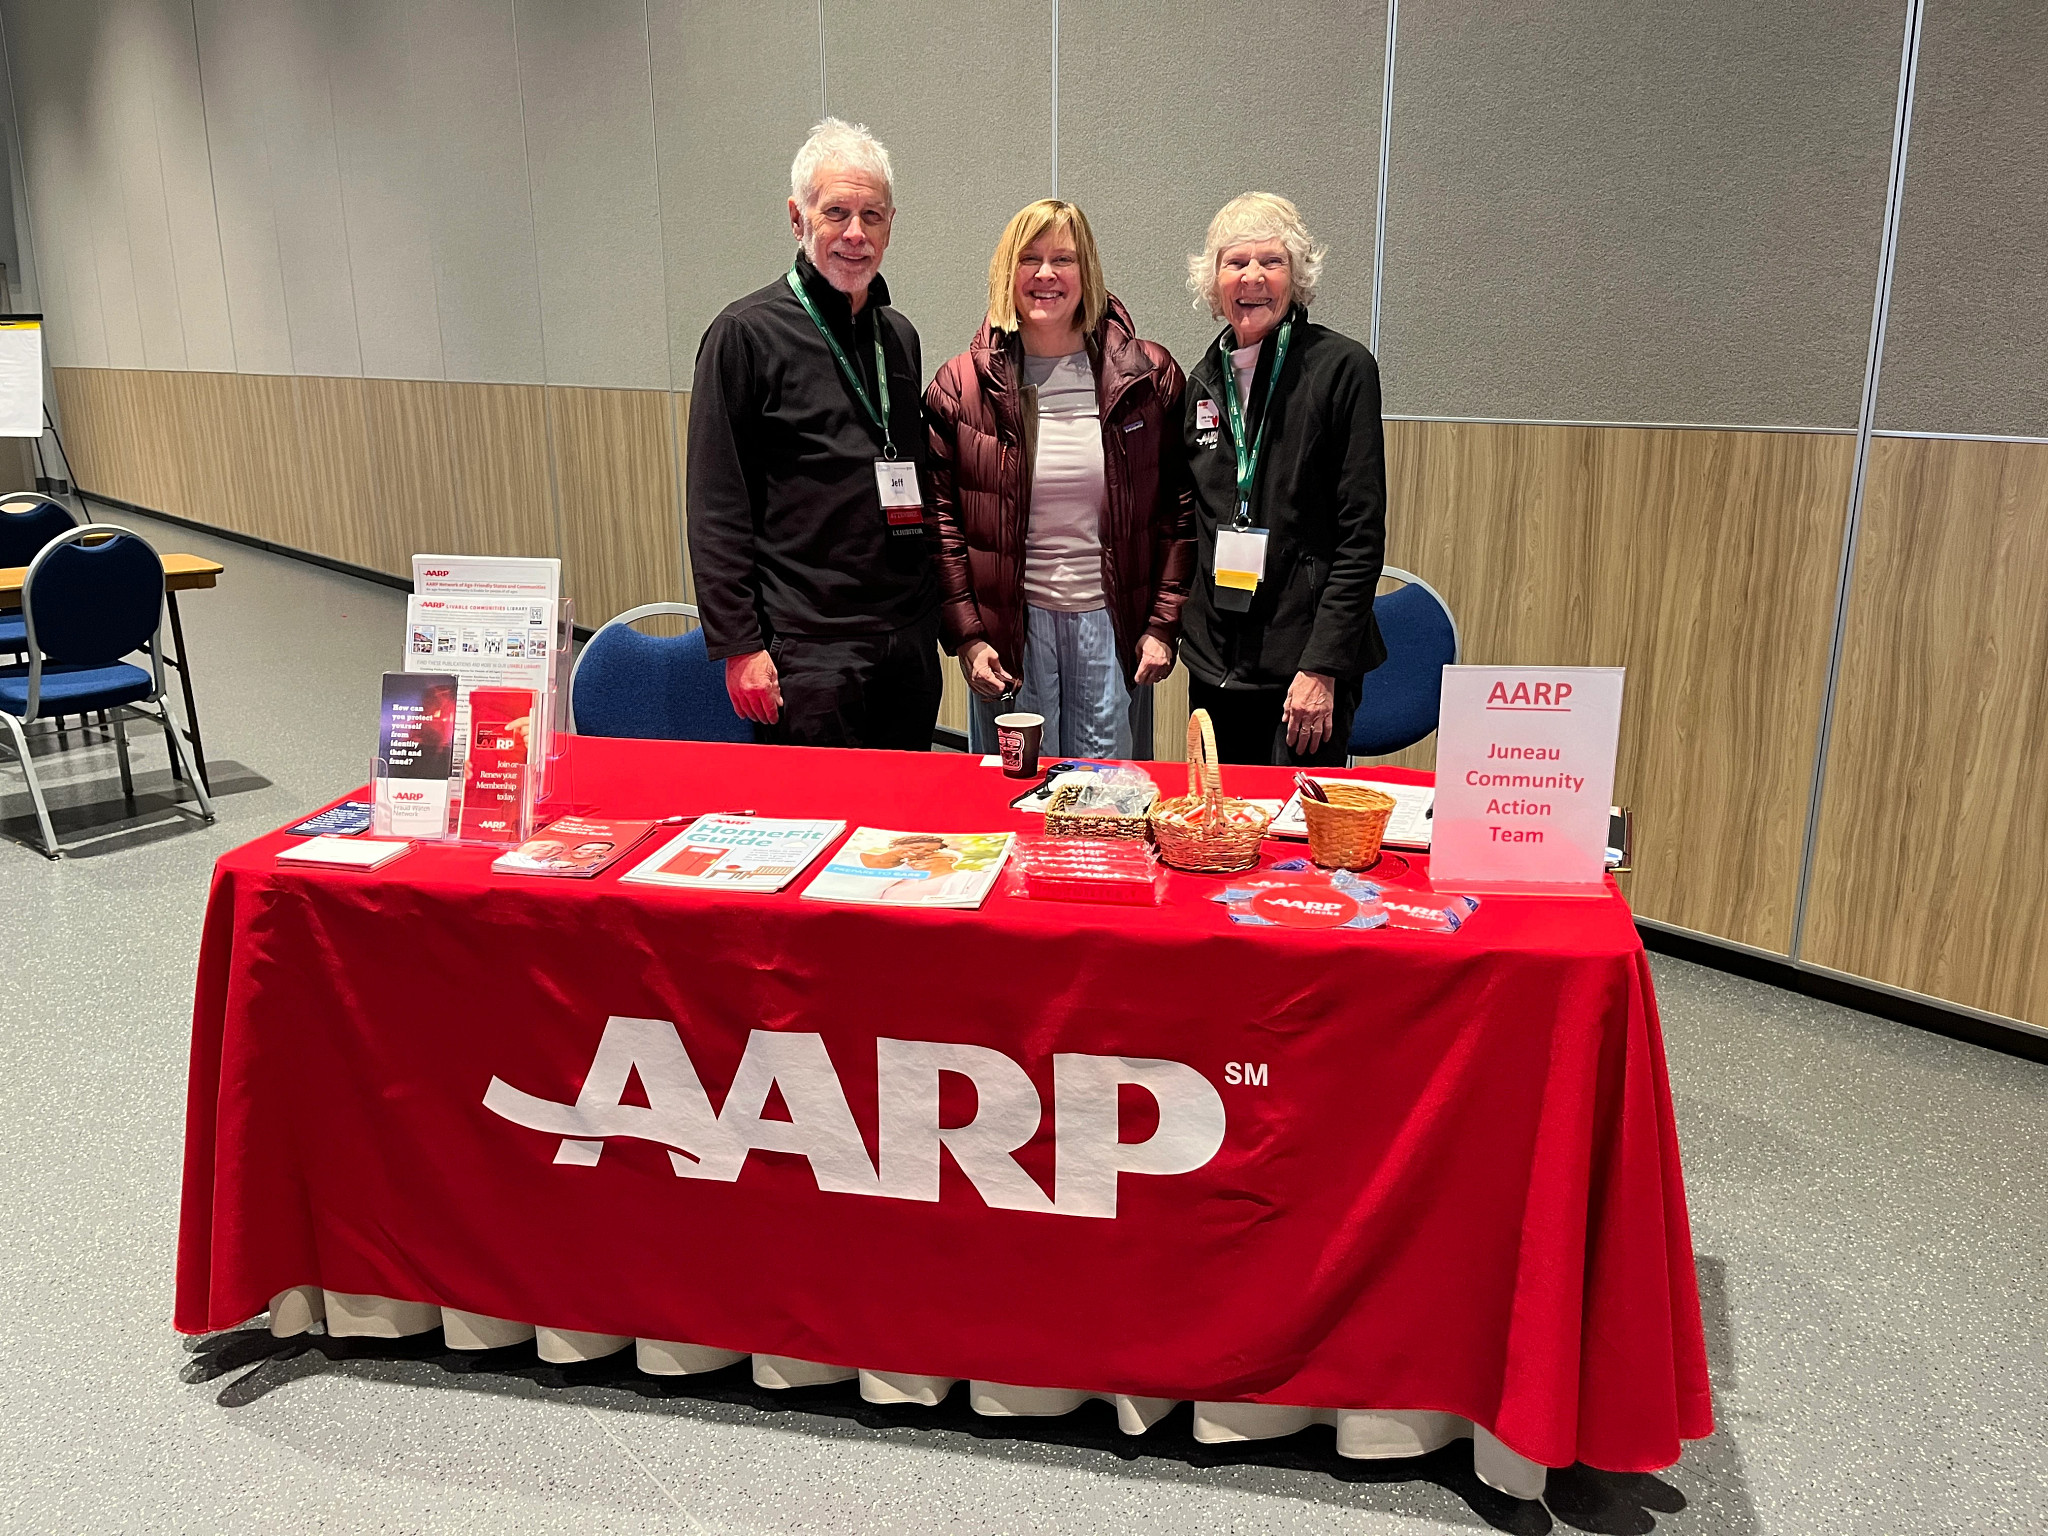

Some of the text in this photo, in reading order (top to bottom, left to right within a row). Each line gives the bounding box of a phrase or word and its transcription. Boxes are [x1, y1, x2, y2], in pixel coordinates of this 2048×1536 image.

[891, 478, 904, 487] Jeff
[1487, 681, 1573, 706] AARP
[390, 740, 419, 749] identity
[1487, 743, 1560, 761] Juneau
[497, 760, 510, 768] Join
[476, 781, 517, 791] Membership
[1465, 770, 1584, 793] Community
[392, 792, 424, 801] AARP
[497, 793, 516, 802] today.
[1486, 799, 1551, 815] Action
[478, 821, 506, 829] AARP
[696, 824, 825, 840] HomeFit
[1489, 827, 1544, 843] Team
[686, 833, 773, 846] Guide
[833, 866, 874, 875] PREPARE
[1264, 899, 1343, 912] AARP
[1382, 902, 1444, 917] AARP
[482, 1015, 1269, 1219] AARP SM
